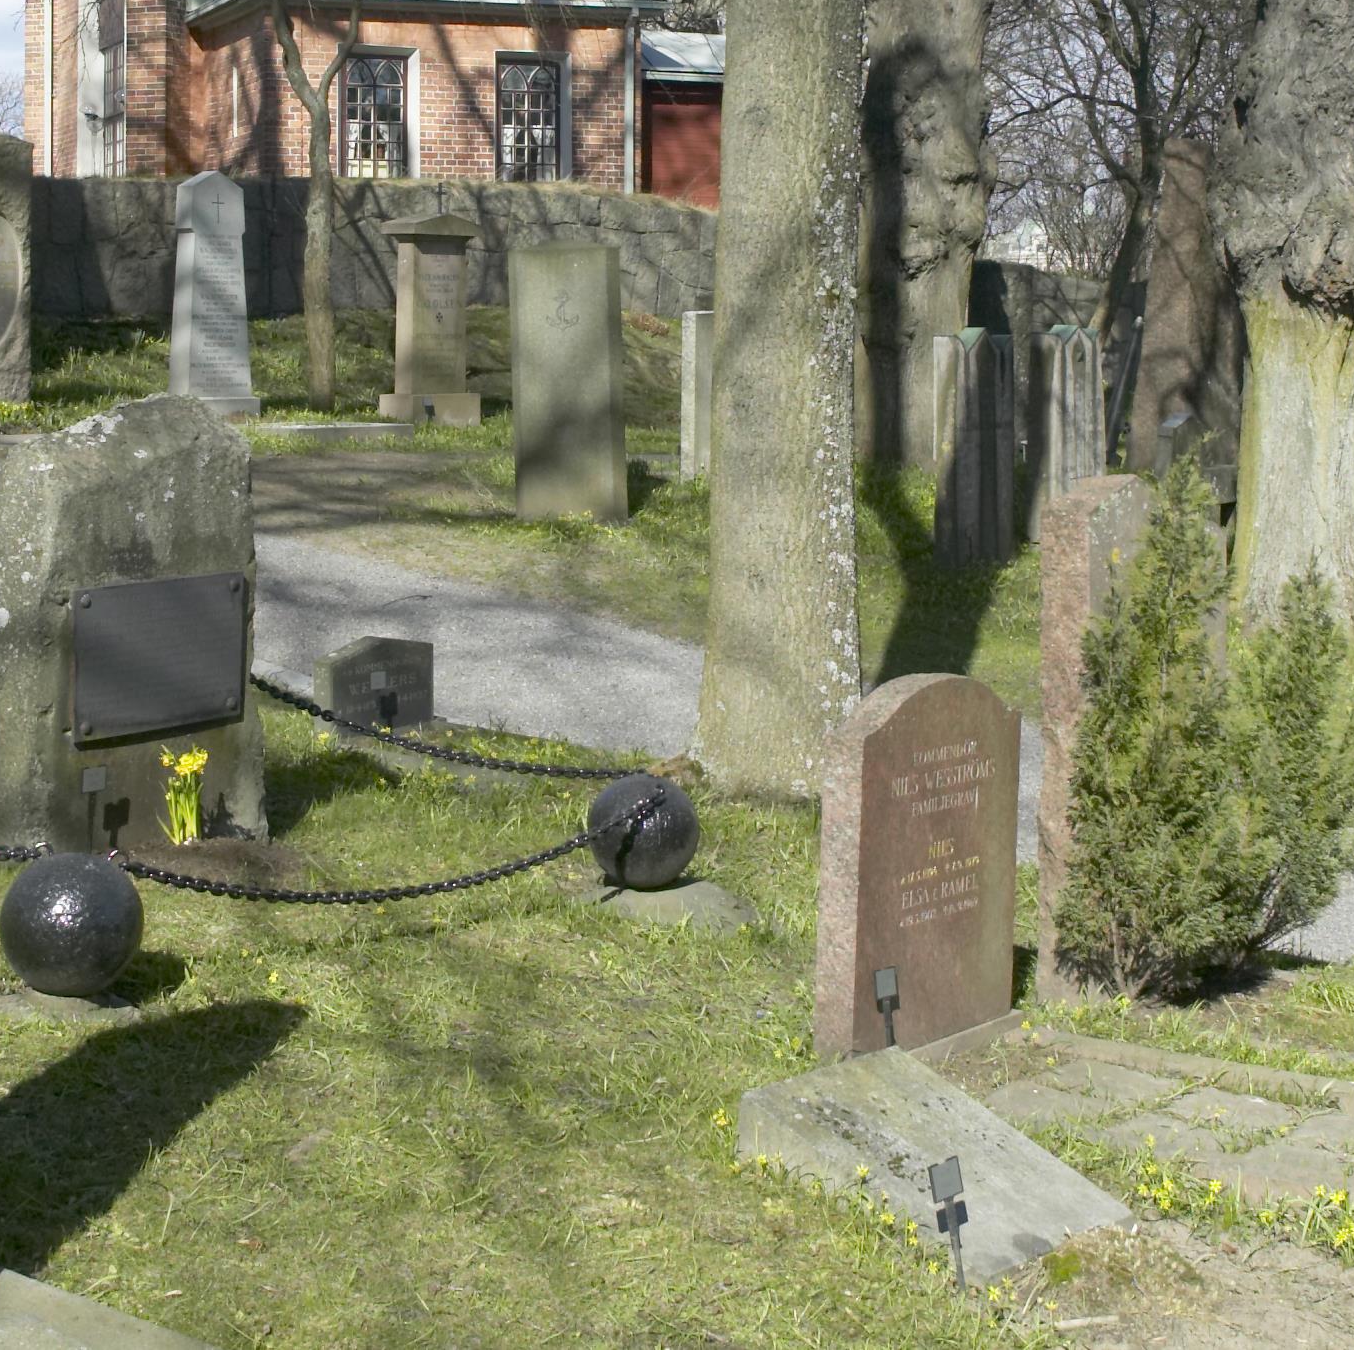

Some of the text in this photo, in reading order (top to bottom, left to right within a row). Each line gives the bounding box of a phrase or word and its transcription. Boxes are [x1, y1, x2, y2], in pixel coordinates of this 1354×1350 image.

[891, 774, 919, 799] NILS
[928, 837, 955, 860] NILS
[902, 886, 930, 910] ELSA
[941, 873, 980, 899] RAMEL
